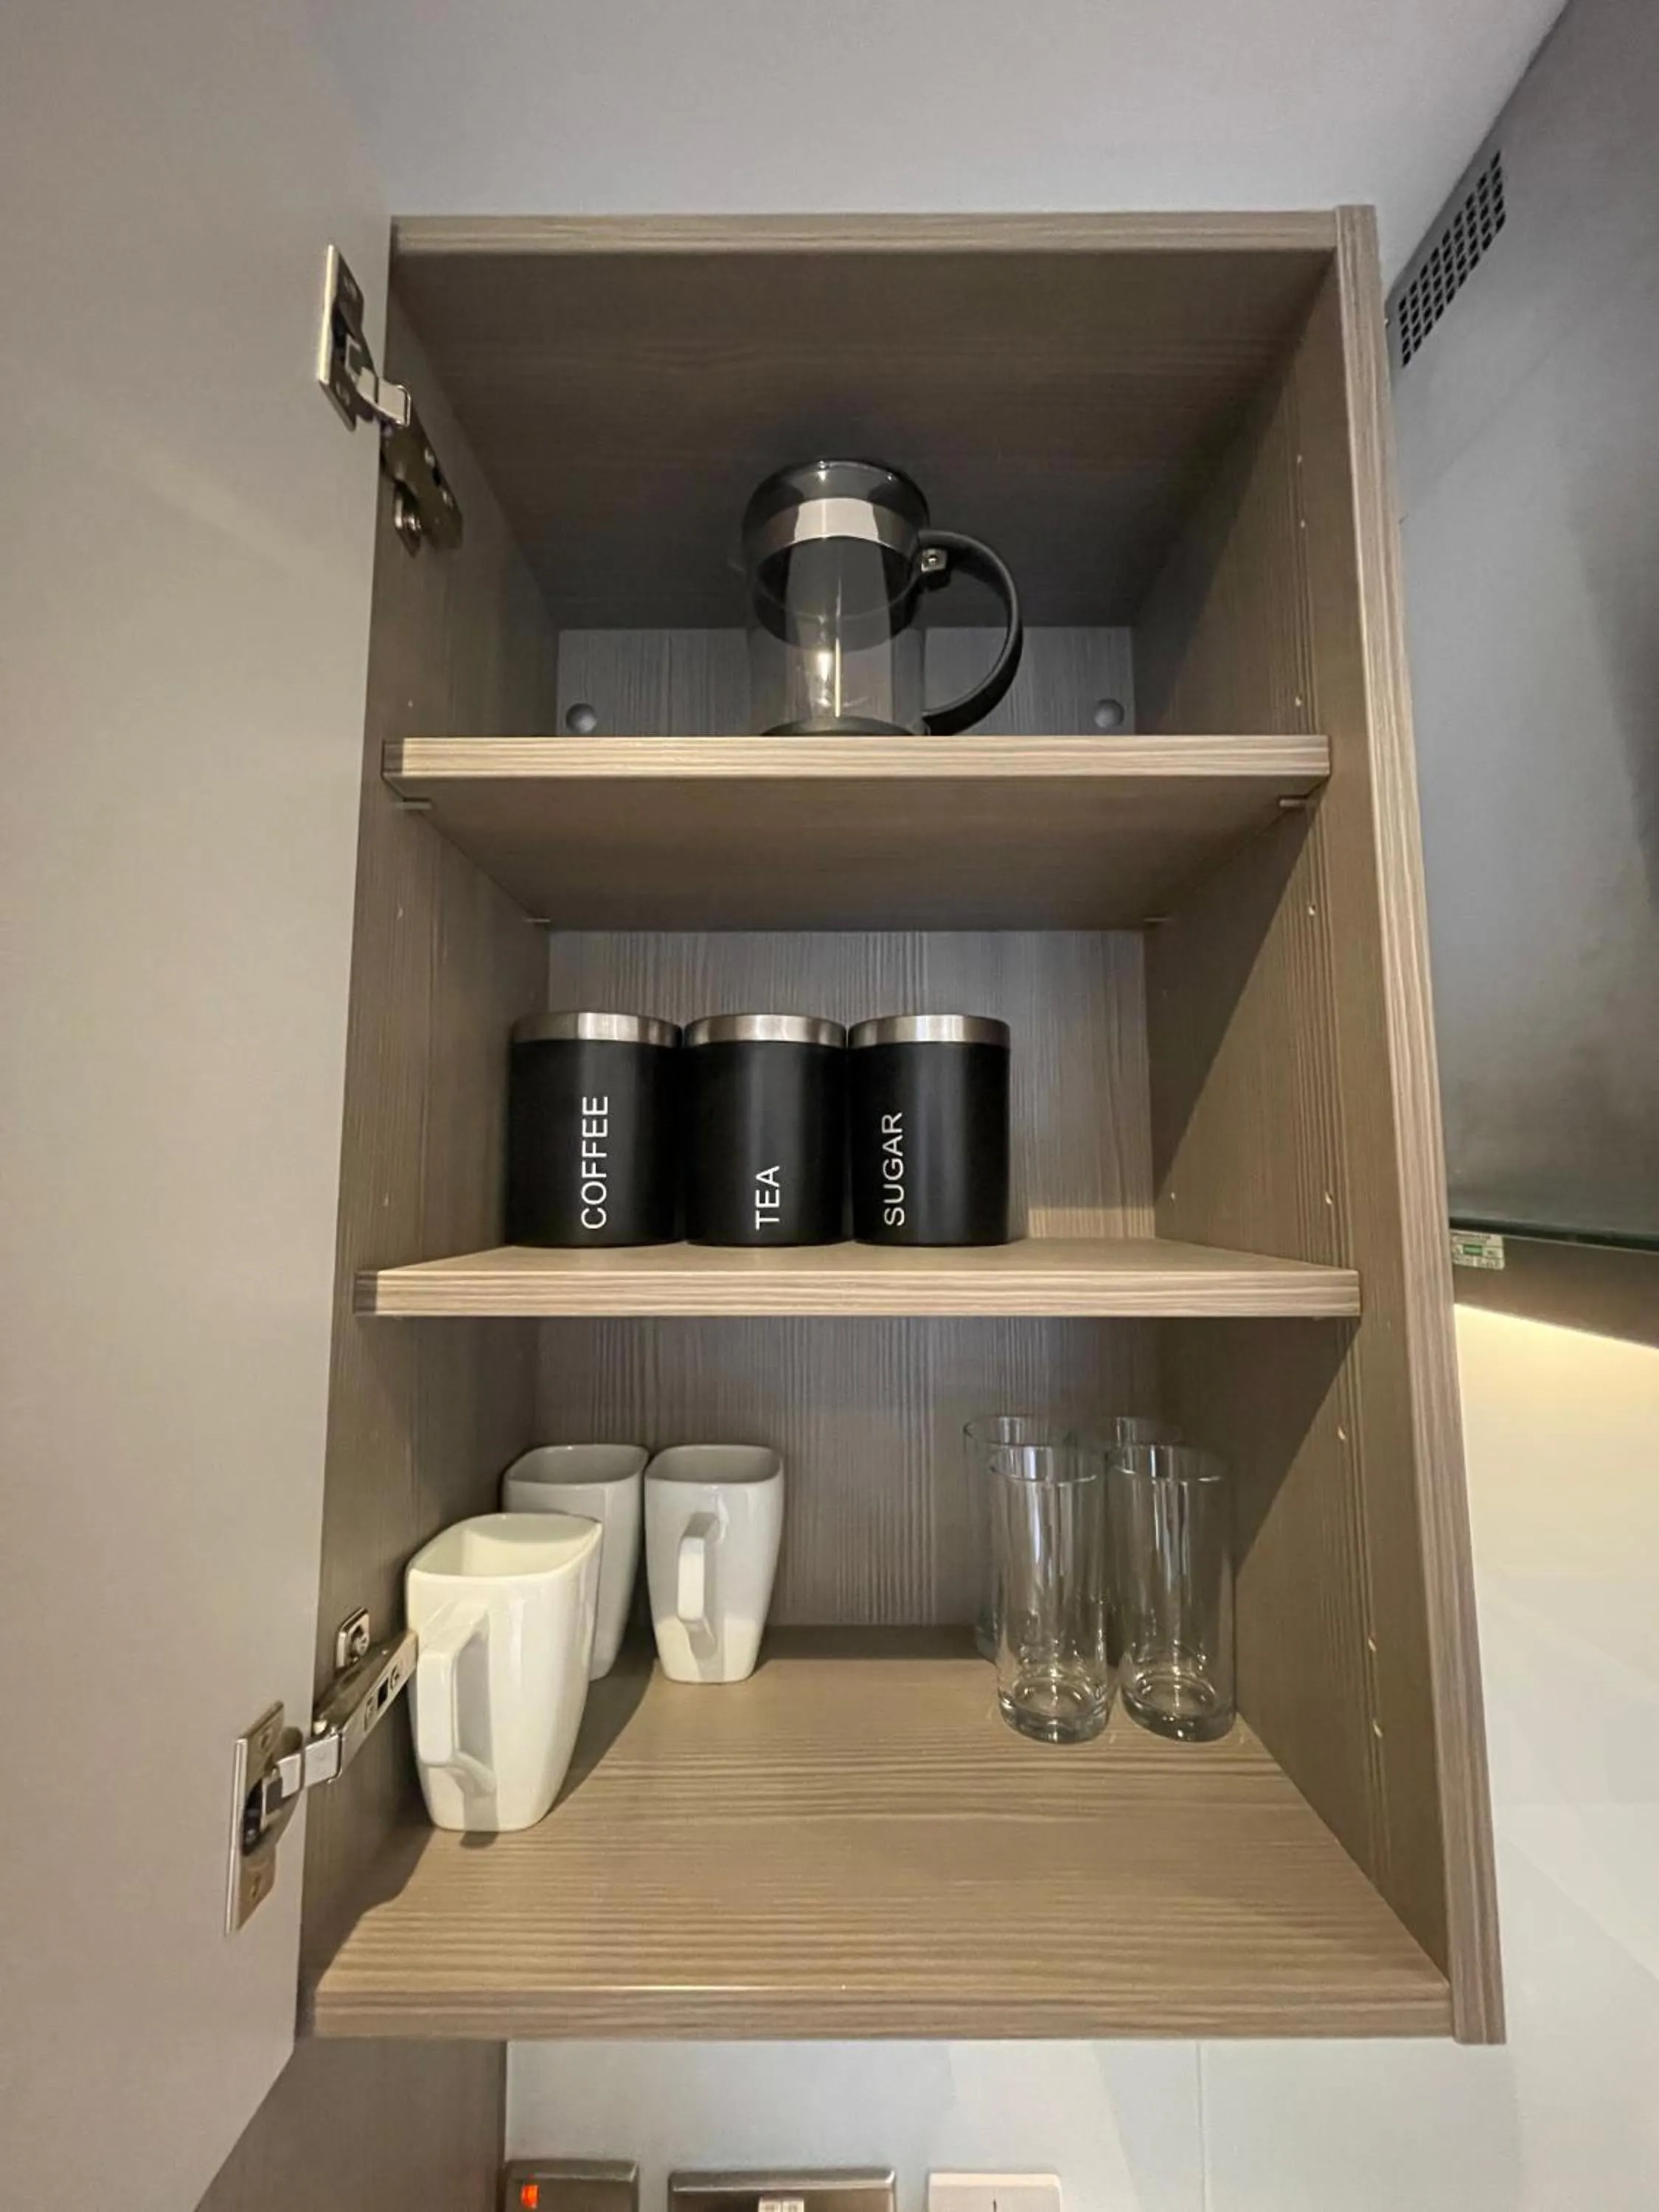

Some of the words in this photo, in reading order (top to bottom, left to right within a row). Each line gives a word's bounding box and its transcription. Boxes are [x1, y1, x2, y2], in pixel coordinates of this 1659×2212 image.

[580, 1096, 609, 1229] COFFEE
[754, 1165, 781, 1231] TEA
[882, 1112, 905, 1226] SUGAR
